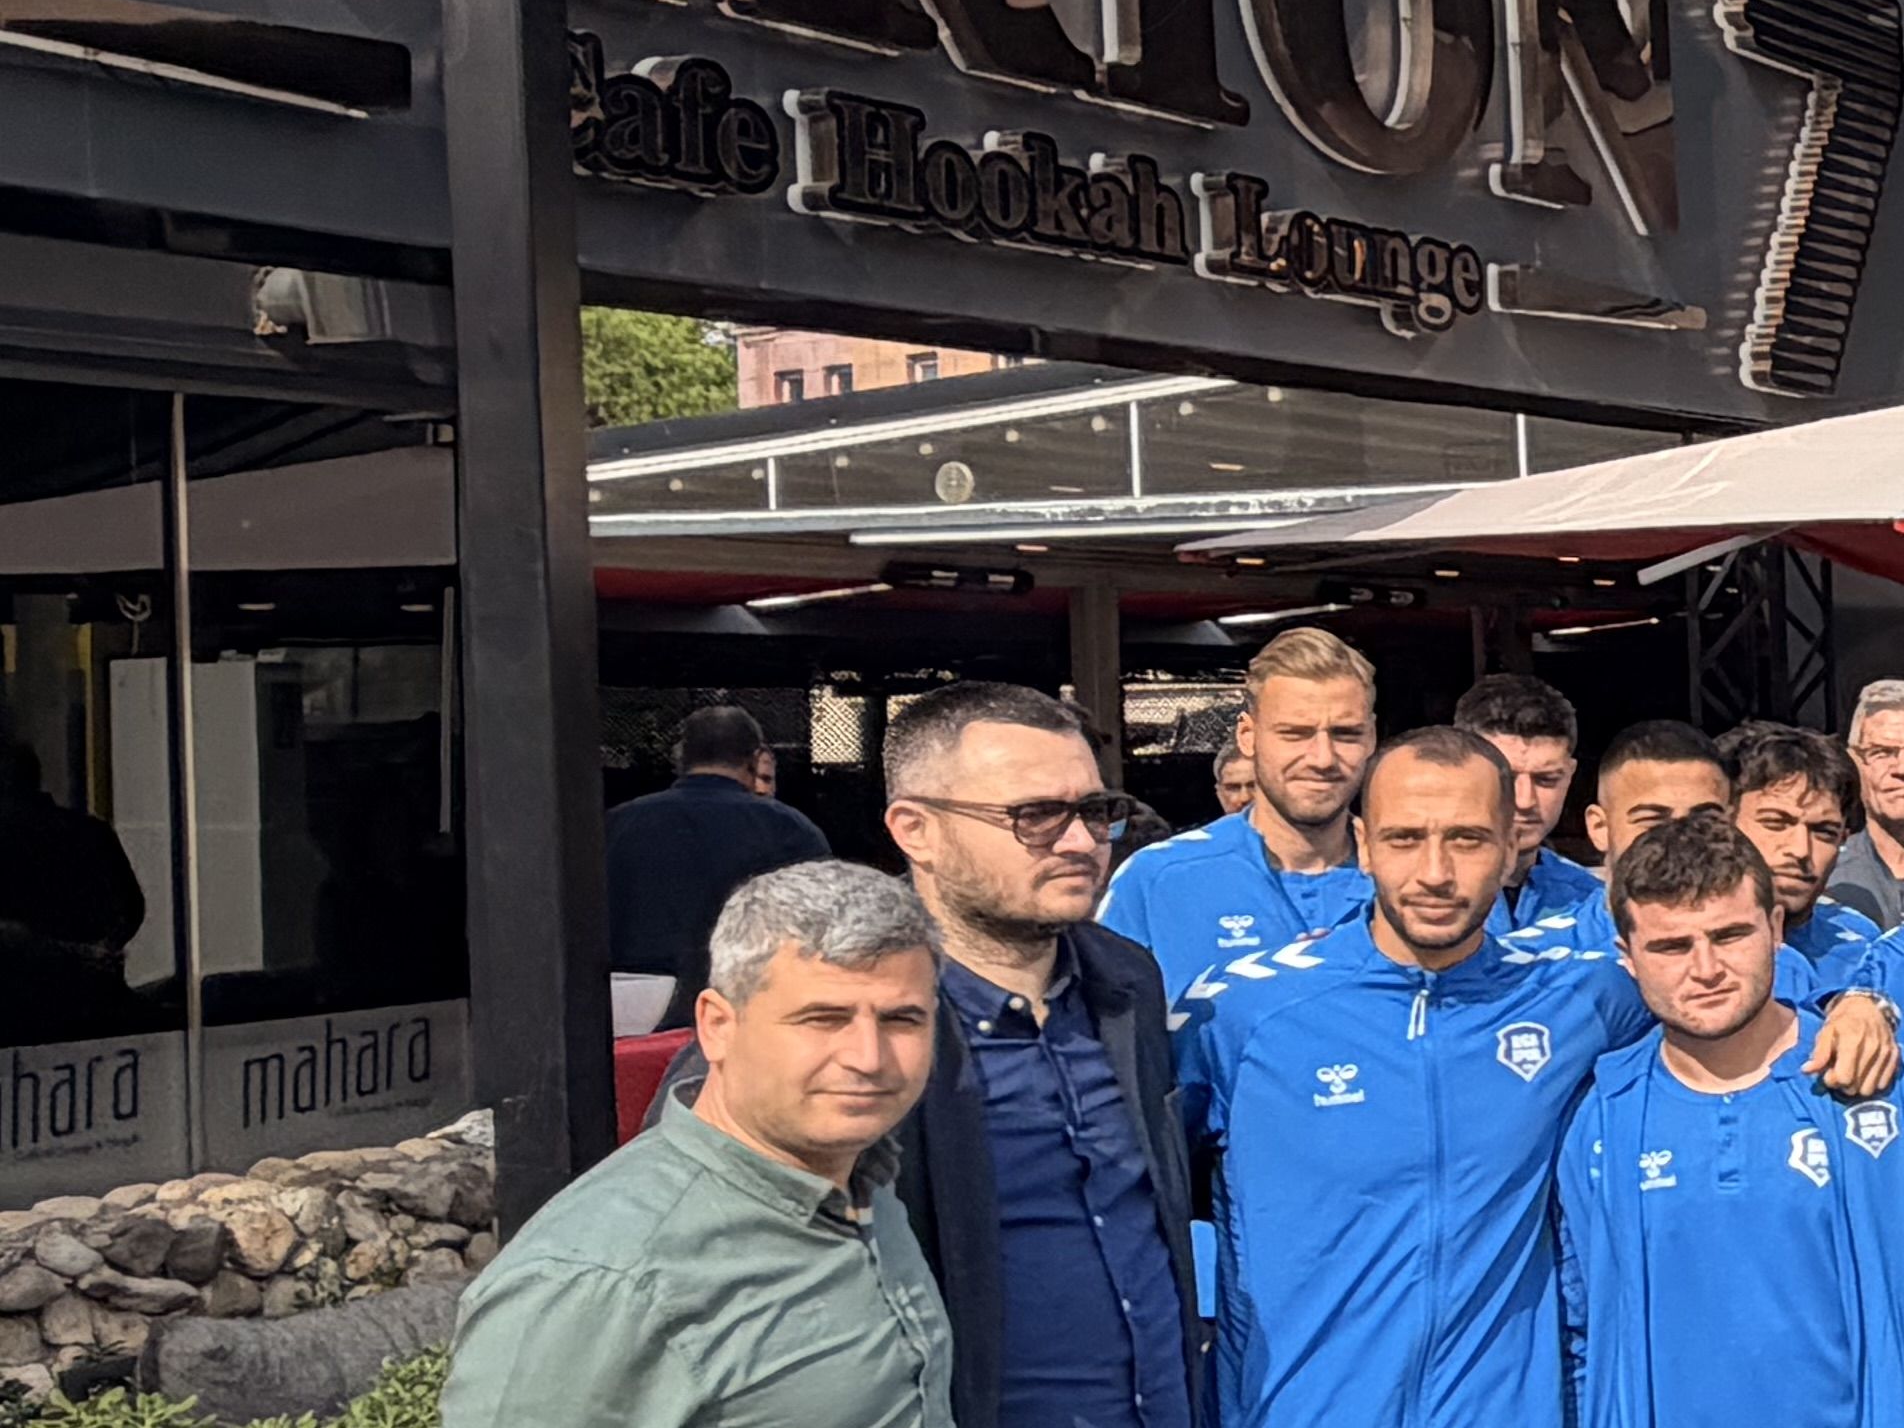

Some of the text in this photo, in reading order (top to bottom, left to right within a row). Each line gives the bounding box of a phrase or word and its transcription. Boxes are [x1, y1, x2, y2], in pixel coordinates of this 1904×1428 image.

[785, 89, 1191, 269] Hookah
[1196, 174, 1484, 340] Lounge
[242, 1017, 431, 1130] mahara
